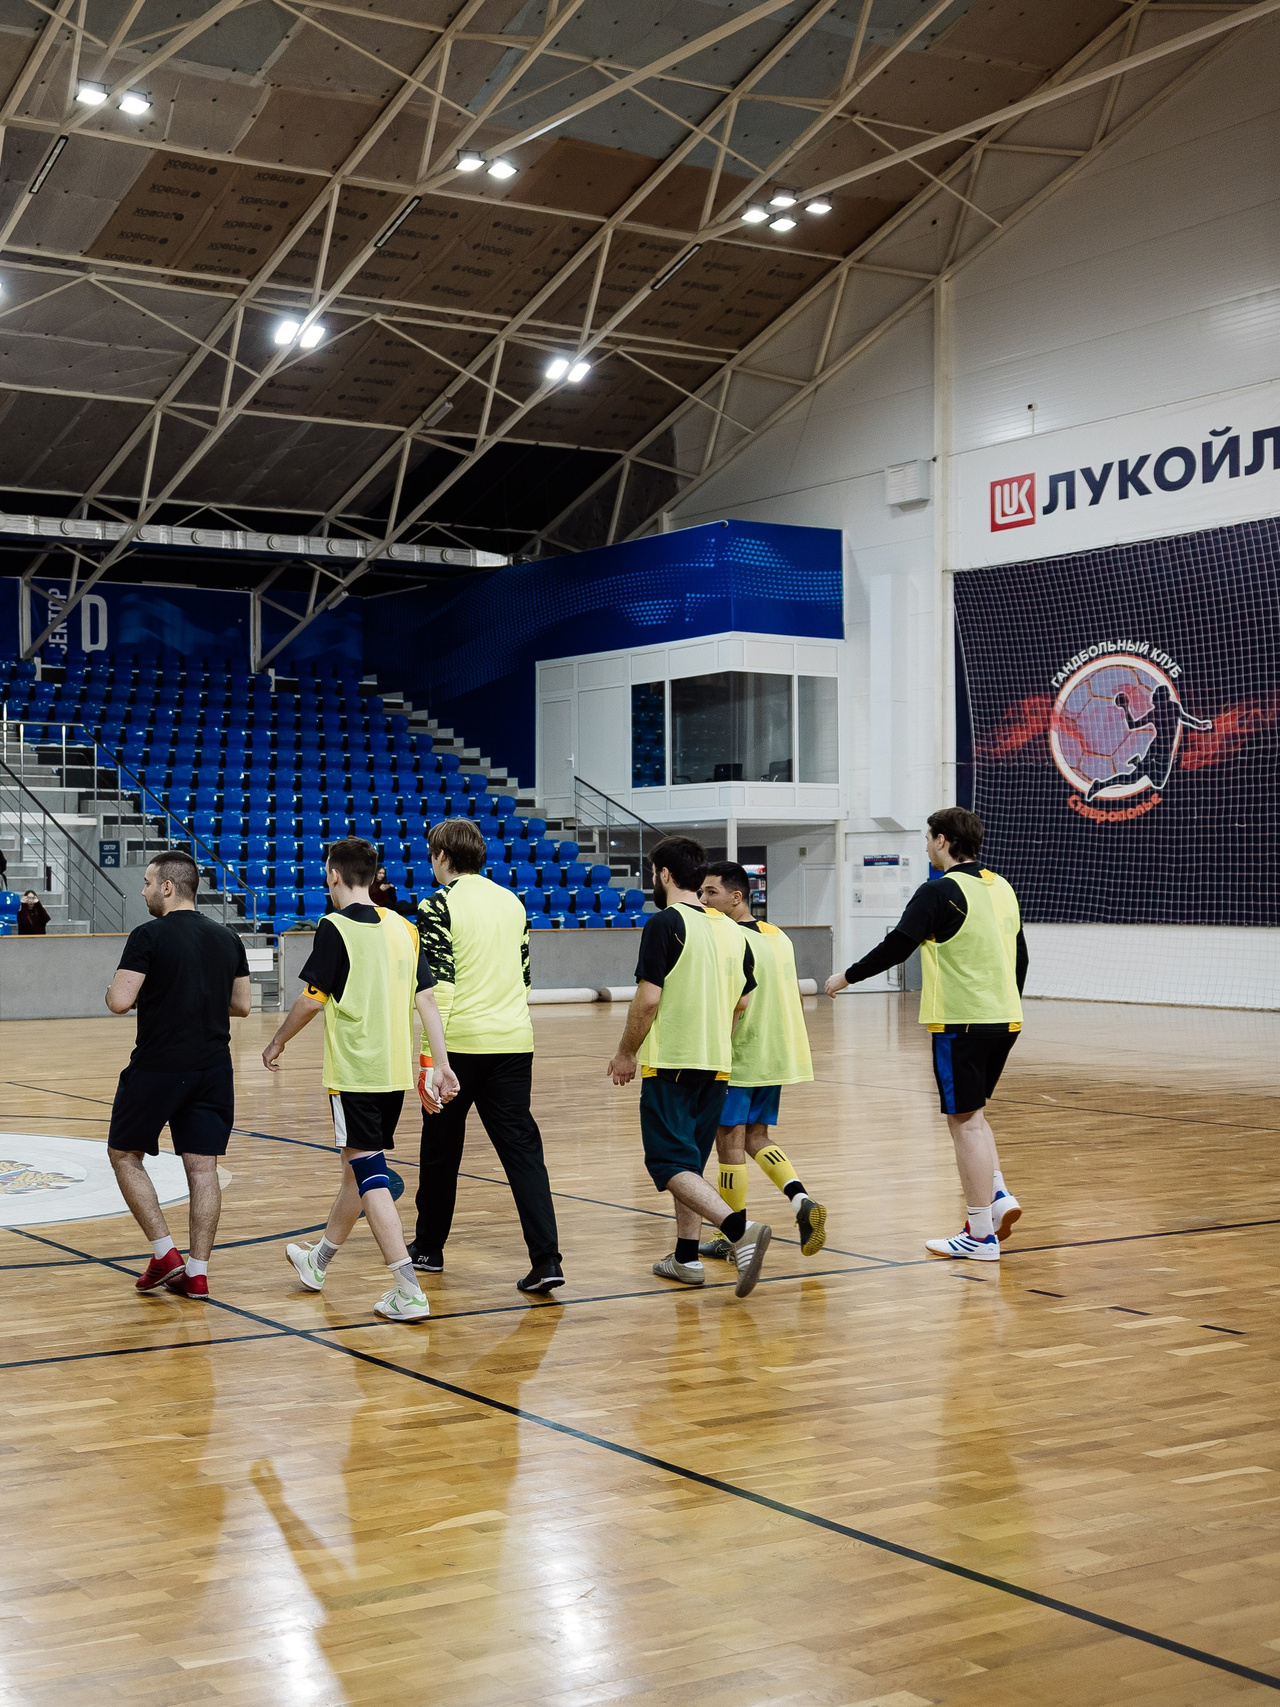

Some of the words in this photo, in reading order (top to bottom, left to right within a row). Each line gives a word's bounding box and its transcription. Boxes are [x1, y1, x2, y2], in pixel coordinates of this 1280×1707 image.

[166, 158, 208, 173] ISOBOX
[149, 183, 191, 197] ISOBOX
[1042, 426, 1280, 515] ЛУКОЙЛ
[81, 594, 108, 653] D
[1051, 639, 1150, 687] ГАНДБОЛЬНЫЙ
[1150, 647, 1183, 679] КЛУБ
[1067, 792, 1163, 824] Ставрополье
